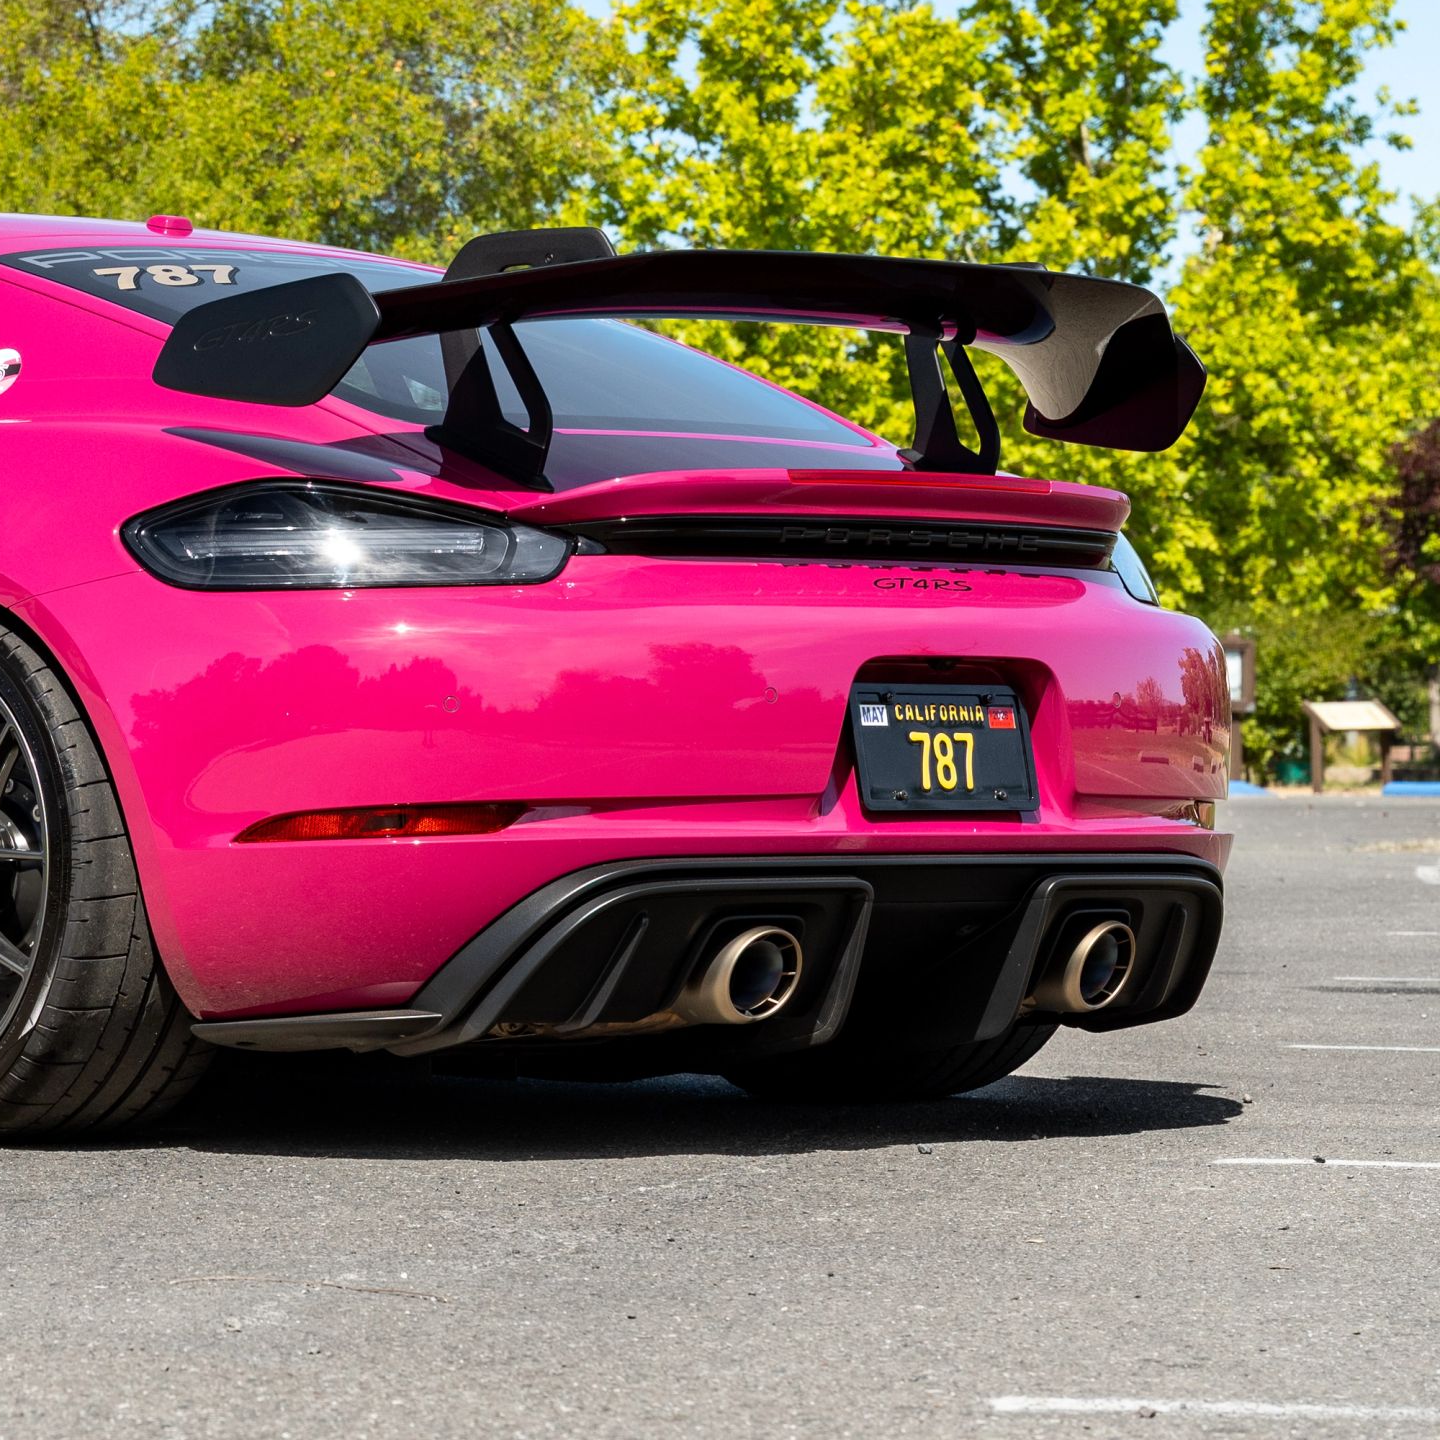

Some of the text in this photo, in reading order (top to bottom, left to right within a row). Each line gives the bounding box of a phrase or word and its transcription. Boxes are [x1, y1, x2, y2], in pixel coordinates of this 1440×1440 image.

[93, 264, 239, 291] 787
[779, 526, 1040, 552] PORSCHE
[861, 706, 885, 723] MAY
[894, 704, 985, 722] CALIFORNIA
[909, 731, 974, 790] 787
